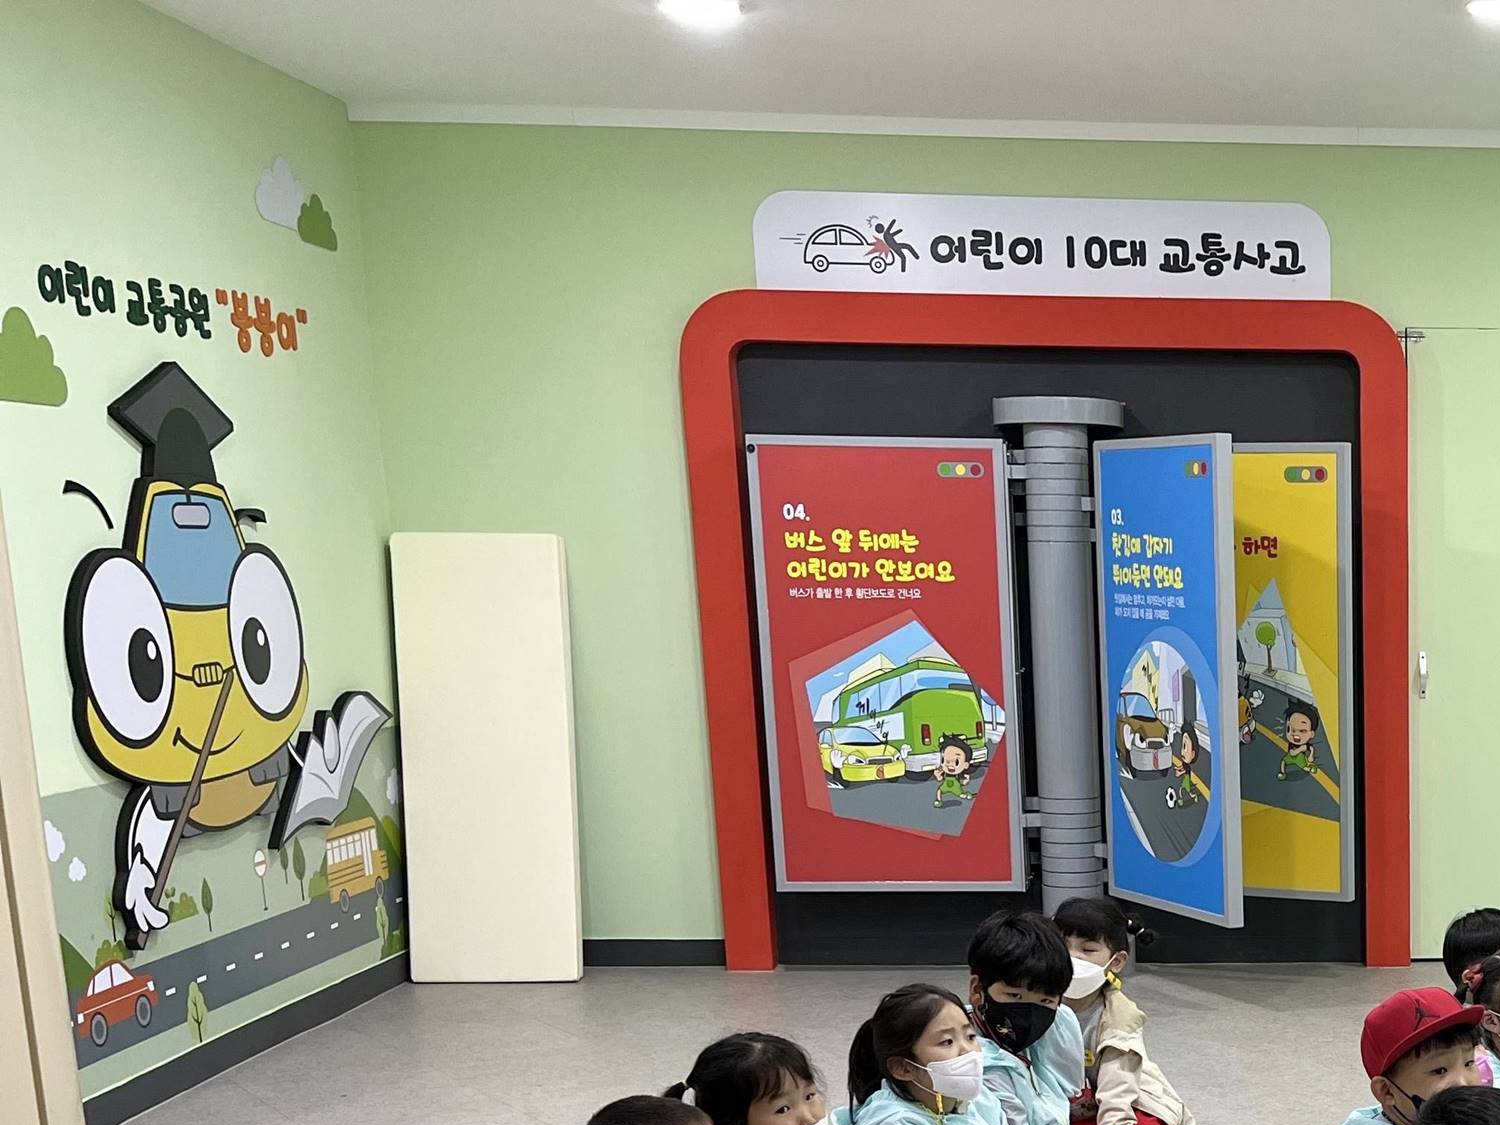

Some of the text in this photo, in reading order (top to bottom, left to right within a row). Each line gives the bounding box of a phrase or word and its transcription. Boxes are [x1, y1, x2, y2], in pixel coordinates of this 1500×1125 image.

[930, 229, 1306, 276] 어린이 10대 교통사고
[37, 260, 116, 317] 어린이
[126, 277, 212, 340] 교통공원
[783, 503, 811, 521] 04.
[1111, 508, 1124, 526] 03.
[784, 528, 920, 553] 버스 앞 뒤에는
[1241, 536, 1278, 559] 하면
[786, 557, 956, 582] 어린이가 안보여요
[789, 587, 814, 599] 버스가
[845, 588, 854, 599] 후
